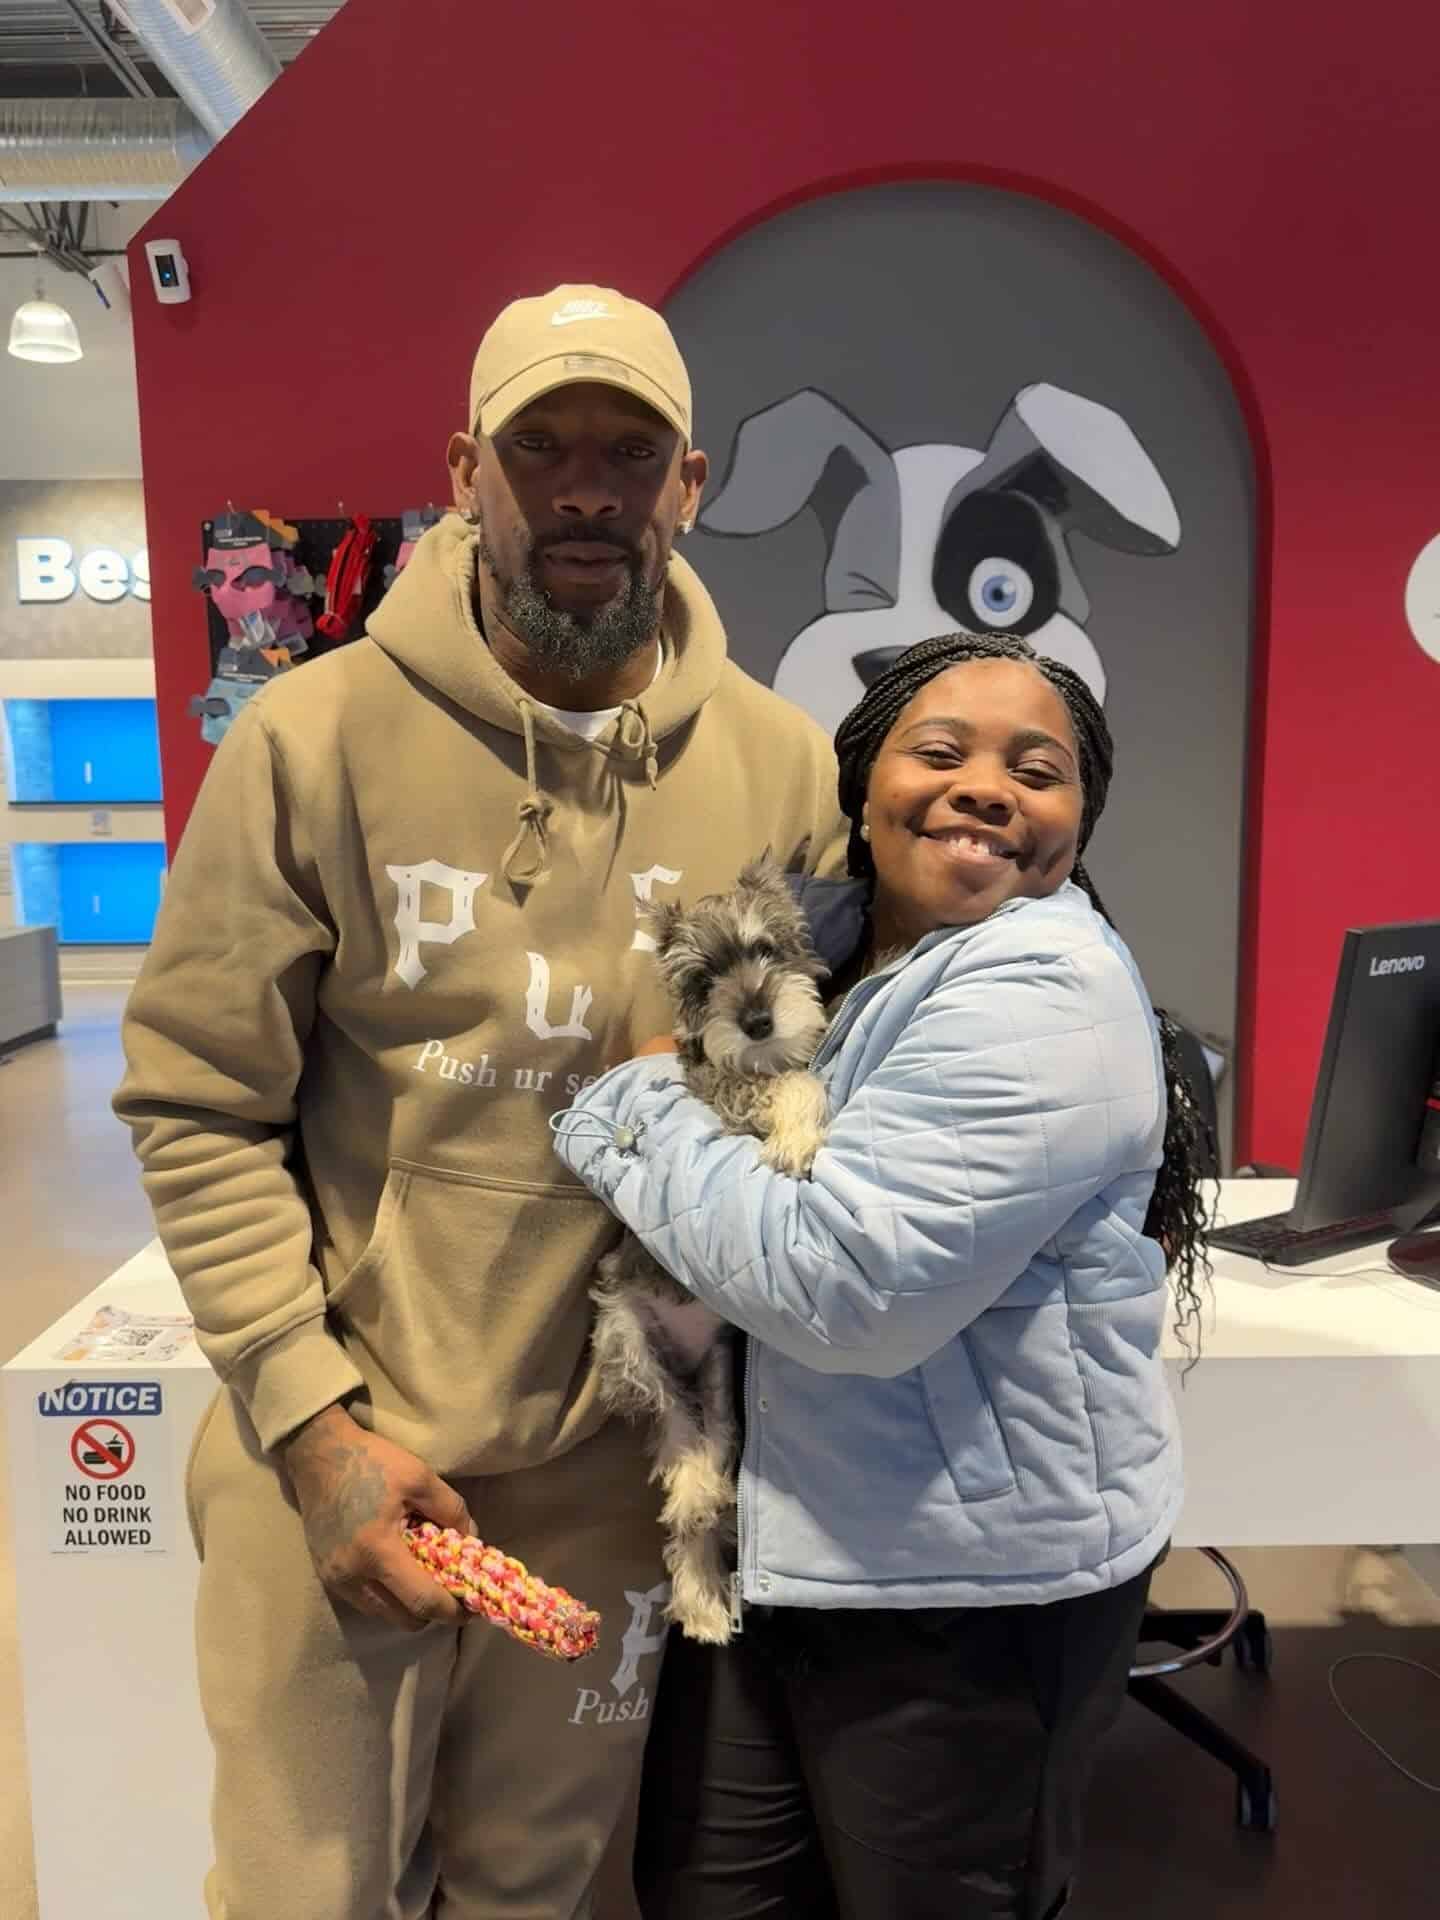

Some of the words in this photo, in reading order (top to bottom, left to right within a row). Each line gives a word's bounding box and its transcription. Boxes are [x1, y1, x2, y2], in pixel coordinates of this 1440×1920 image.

[385, 858, 489, 991] P
[1369, 955, 1425, 976] Lenovo
[412, 1038, 497, 1088] Push
[514, 1067, 553, 1092] ur
[42, 1386, 158, 1411] NOTICE
[65, 1485, 91, 1500] NO
[97, 1484, 146, 1500] FOOD
[63, 1507, 89, 1523] NO
[94, 1507, 152, 1523] DRINK
[65, 1529, 151, 1545] ALLOWED
[567, 1687, 649, 1725] Push
